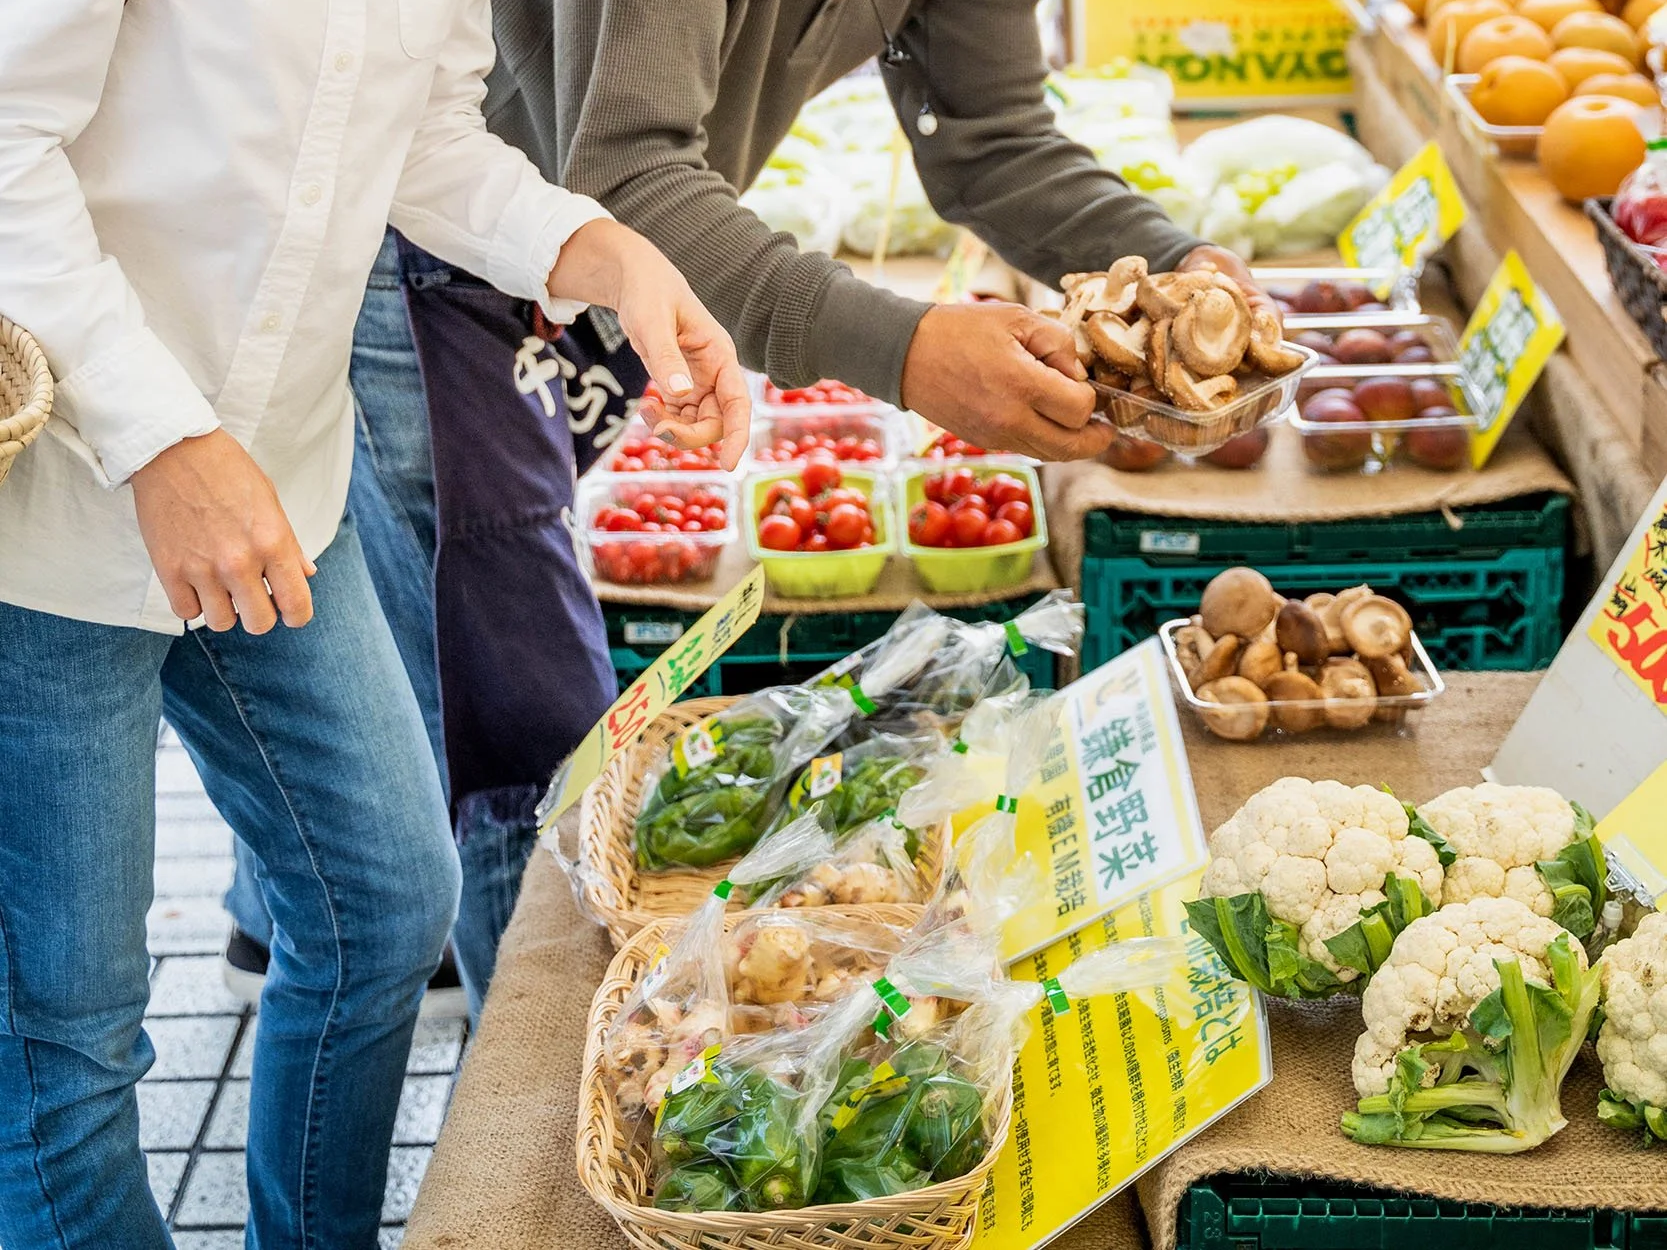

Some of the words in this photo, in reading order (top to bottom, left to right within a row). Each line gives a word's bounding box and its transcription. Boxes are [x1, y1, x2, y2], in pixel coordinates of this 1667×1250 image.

[608, 682, 646, 750] 250
[1081, 717, 1159, 889] 鎌倉野菜
[1181, 920, 1244, 1064] M栽培とは
